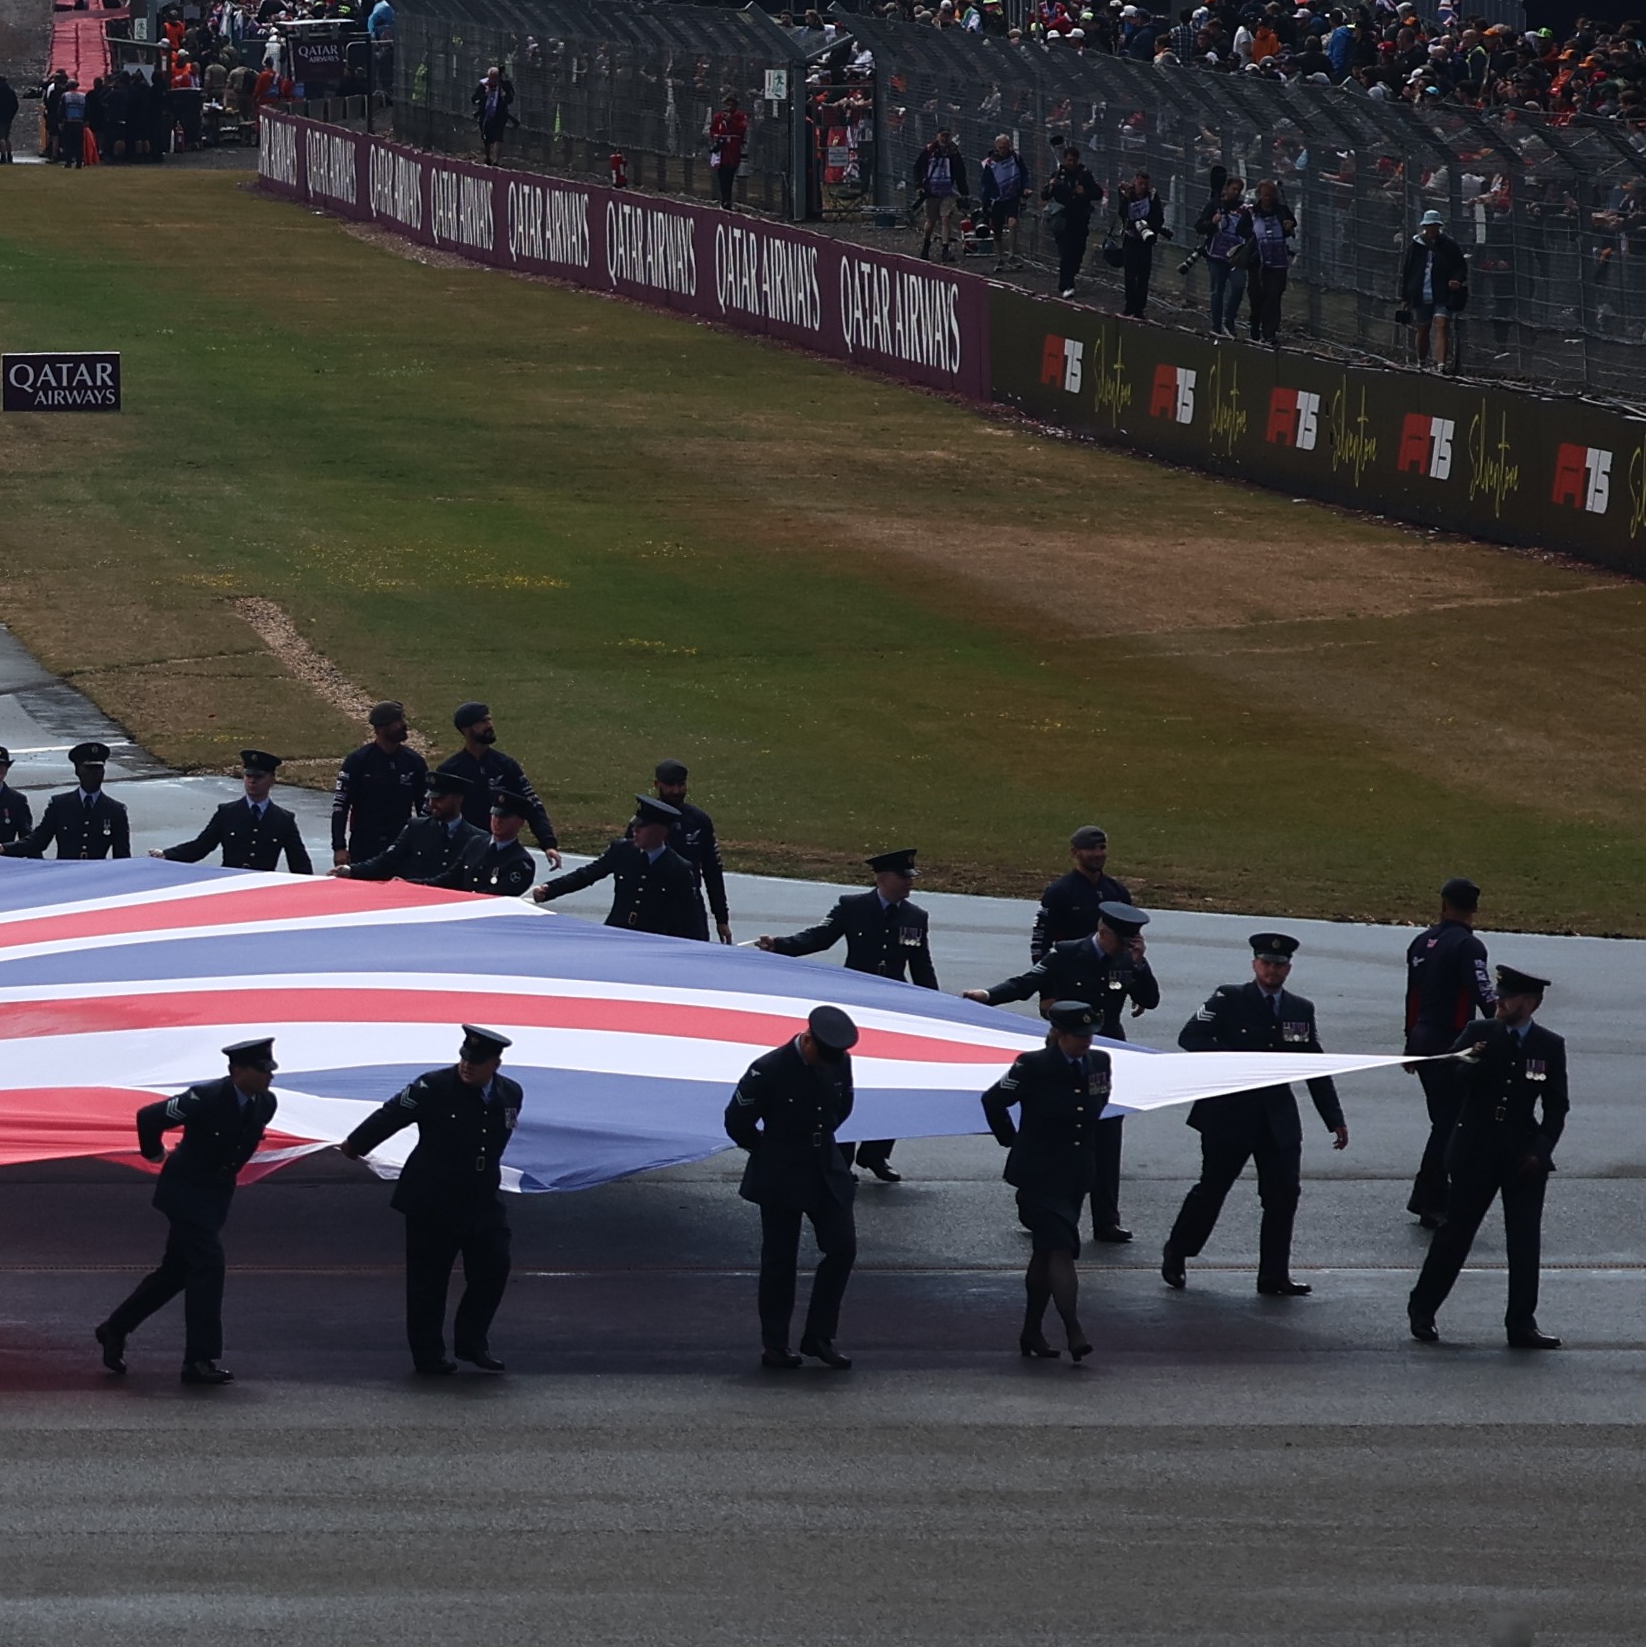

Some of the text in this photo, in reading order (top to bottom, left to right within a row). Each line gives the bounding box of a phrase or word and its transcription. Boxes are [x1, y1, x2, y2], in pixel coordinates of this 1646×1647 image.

[299, 44, 338, 58] QATAR
[431, 167, 458, 244] QATAR
[508, 181, 590, 268] QATAR AIRWAYS
[606, 200, 697, 297] QATAR AIRWAYS
[715, 223, 821, 331] QATAR AIRWAYS
[840, 255, 961, 374] QATAR AIRWAYS
[9, 362, 114, 393] QATAR
[34, 389, 116, 406] AIRWAYS
[1064, 338, 1084, 394] 75
[1176, 367, 1197, 424] 75
[1295, 390, 1321, 451] 75
[1429, 416, 1455, 481] 75
[1585, 447, 1613, 514] 75
